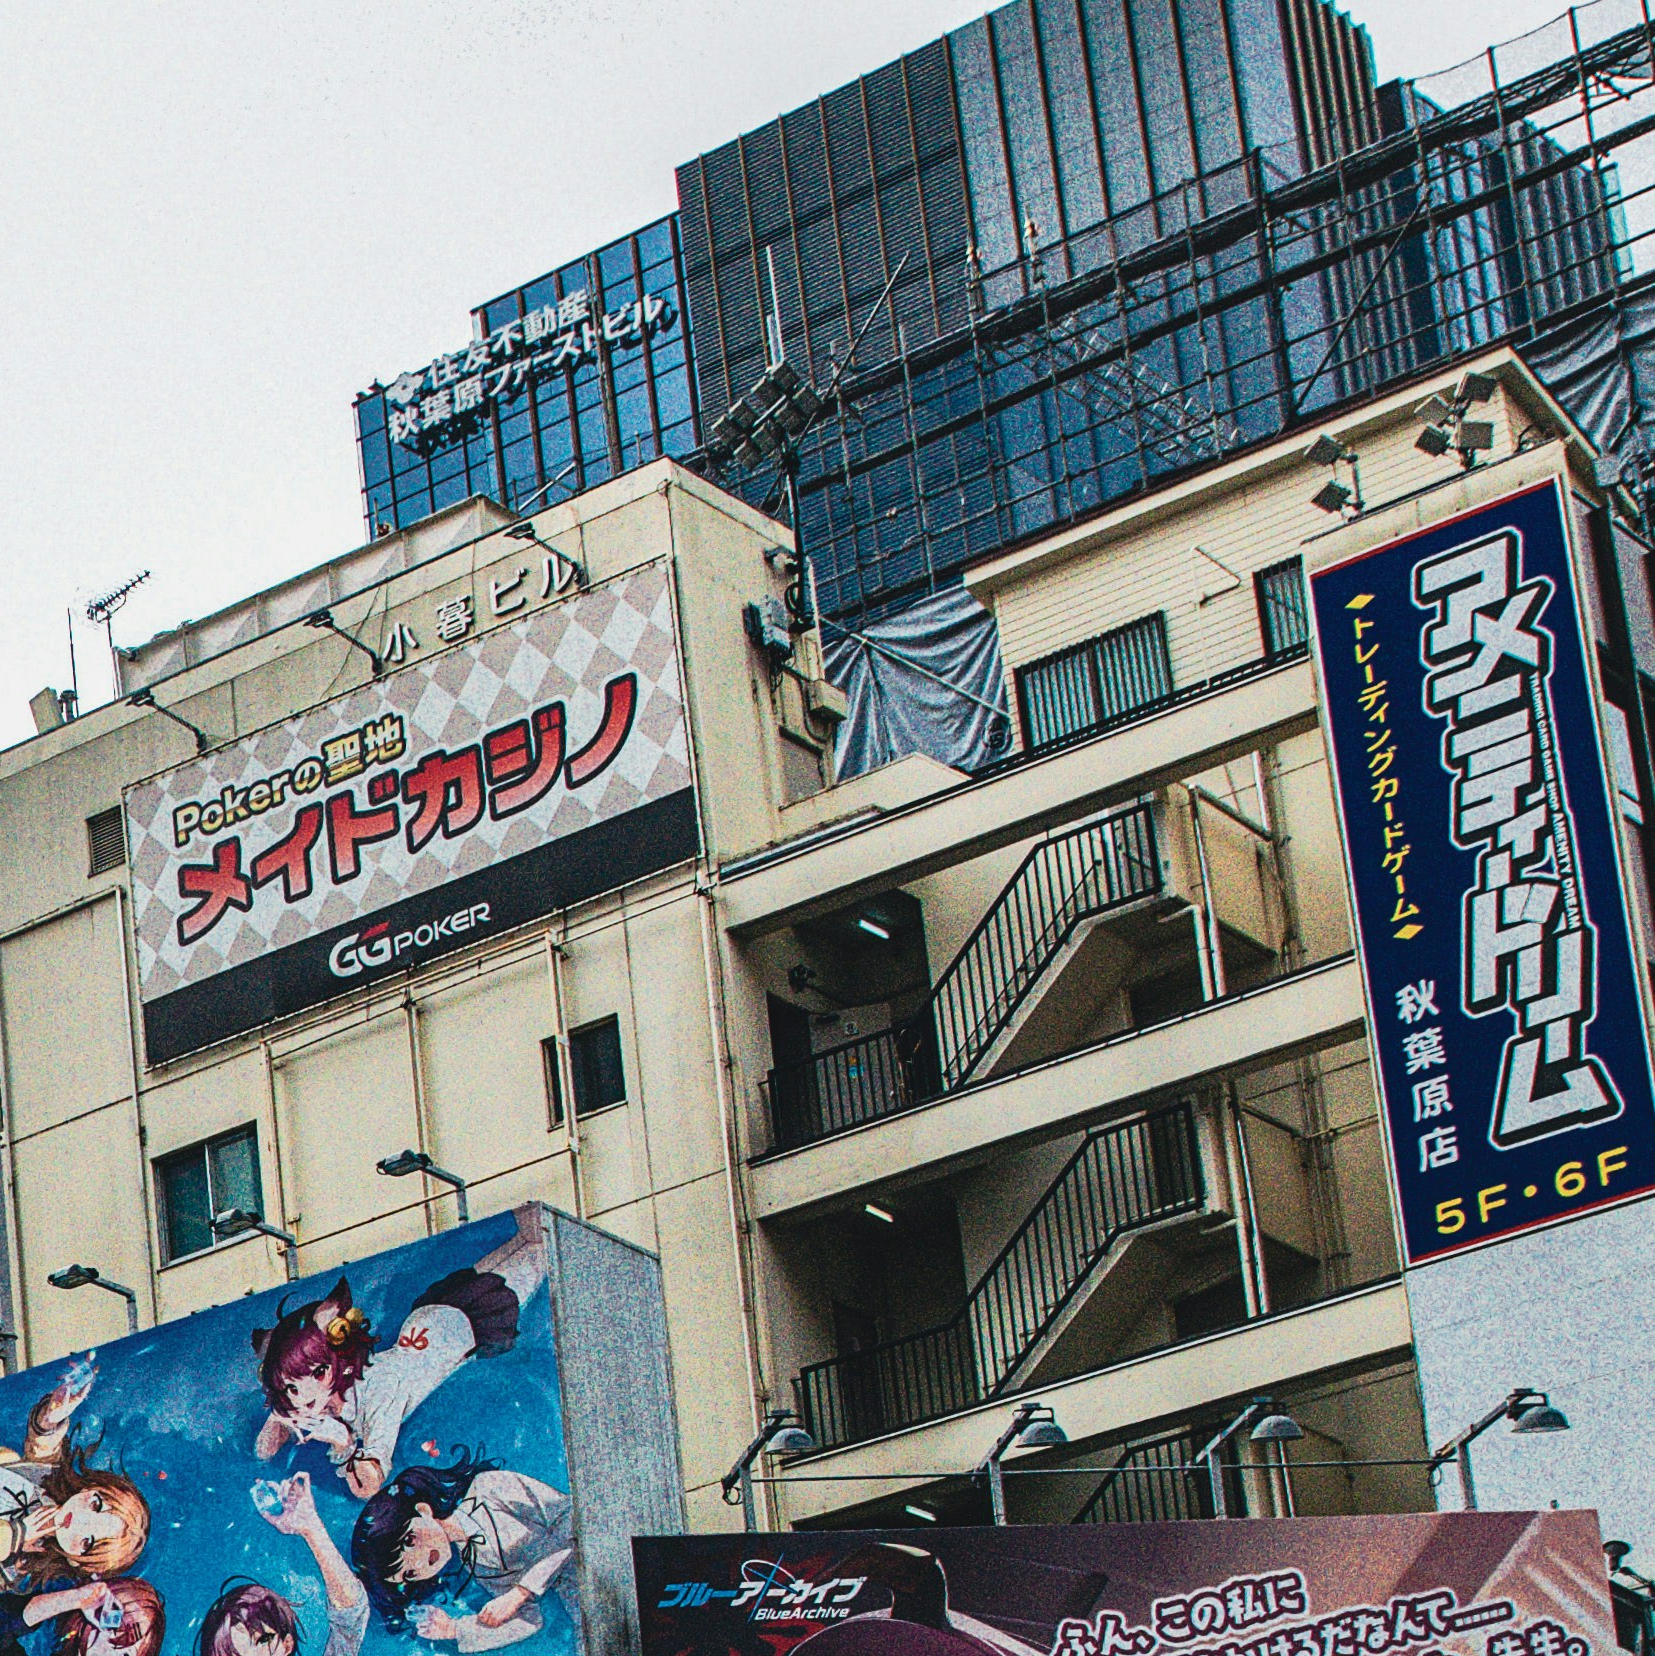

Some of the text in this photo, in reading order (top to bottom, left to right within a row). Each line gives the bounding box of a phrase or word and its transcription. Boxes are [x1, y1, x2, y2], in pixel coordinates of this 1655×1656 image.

[389, 295, 668, 442] 秋葉原ファーストビル
[428, 289, 592, 387] 住友不動産
[383, 555, 573, 664] 小暮ビル
[174, 713, 408, 847] Pokerの聖地
[177, 672, 639, 945] メイドカジノ
[1352, 617, 1421, 922] トレーディングカードゲーム
[1552, 811, 1571, 875] AMENITY
[1561, 876, 1582, 930] DREAM
[1395, 980, 1463, 1175] 秋葉原店
[658, 1575, 869, 1609] ブルーアーカイブ
